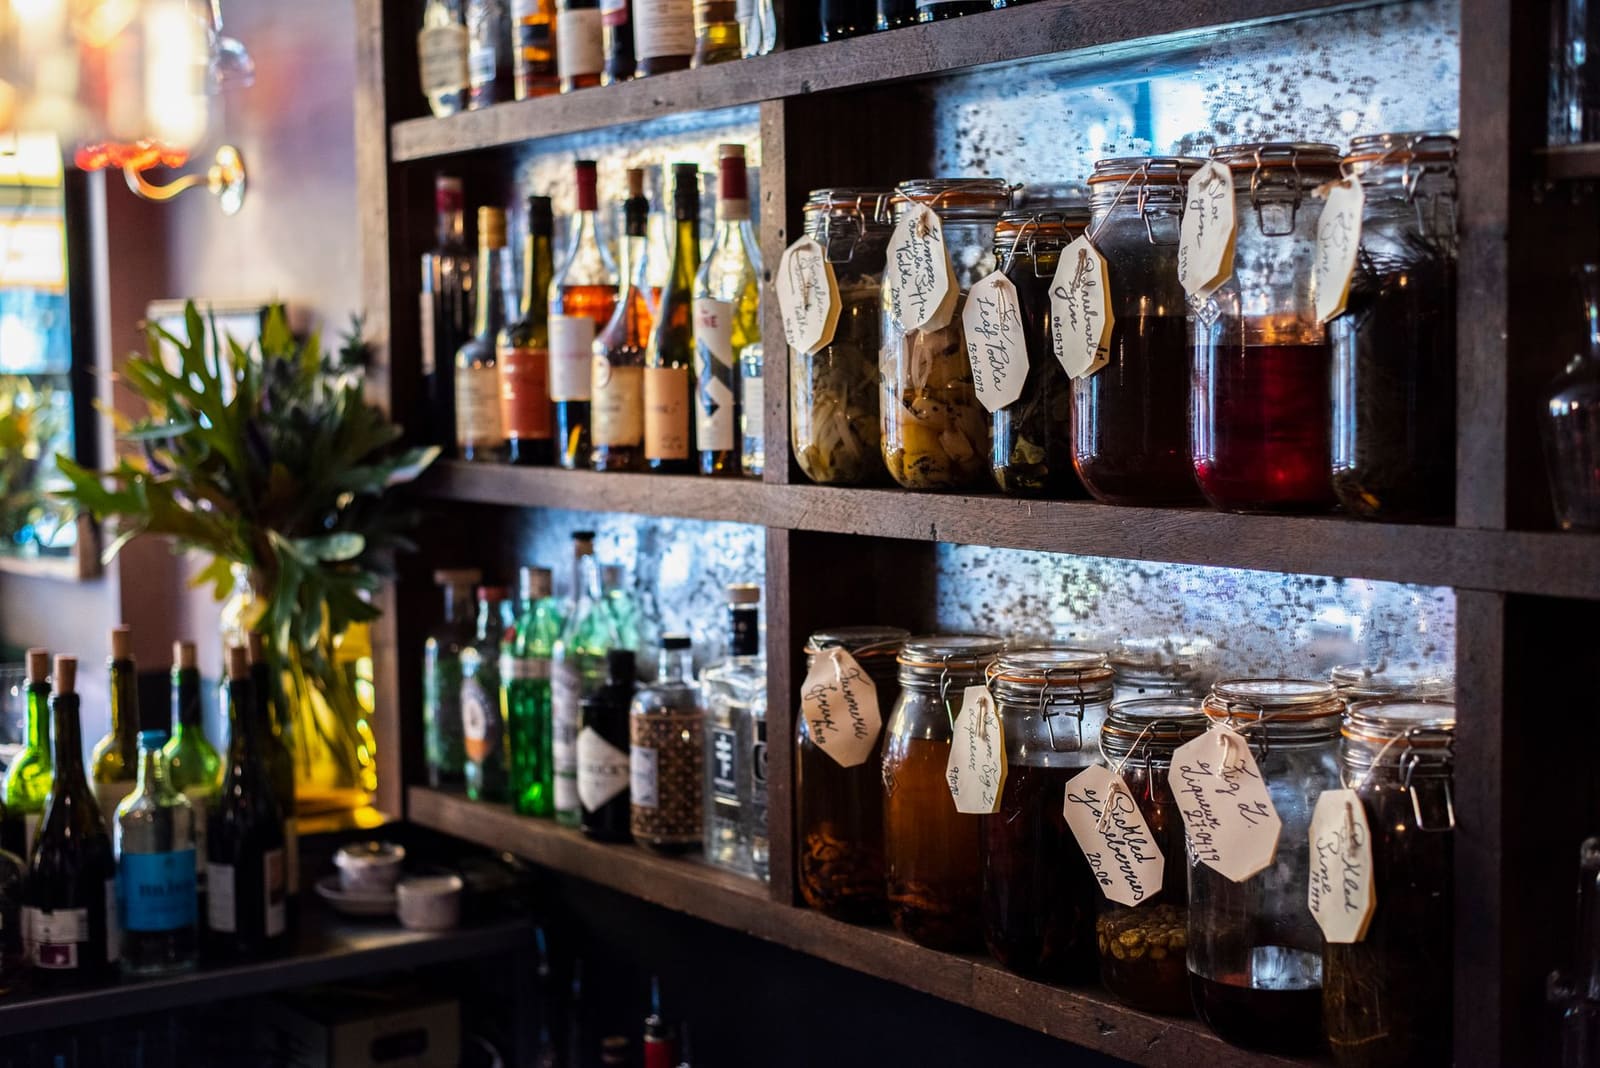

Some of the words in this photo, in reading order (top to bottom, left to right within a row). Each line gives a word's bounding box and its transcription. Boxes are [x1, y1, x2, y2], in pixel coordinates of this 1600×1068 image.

[1208, 180, 1226, 226] Sloe
[896, 240, 914, 289] Vodka
[975, 296, 998, 340] Leaf
[985, 340, 1010, 392] Vodka
[1180, 760, 1221, 829] Liqueur
[1067, 788, 1144, 901] Goeberries
[1111, 791, 1157, 863] Pickled
[1087, 852, 1113, 886] 20-06
[1340, 822, 1365, 913] Pkled
